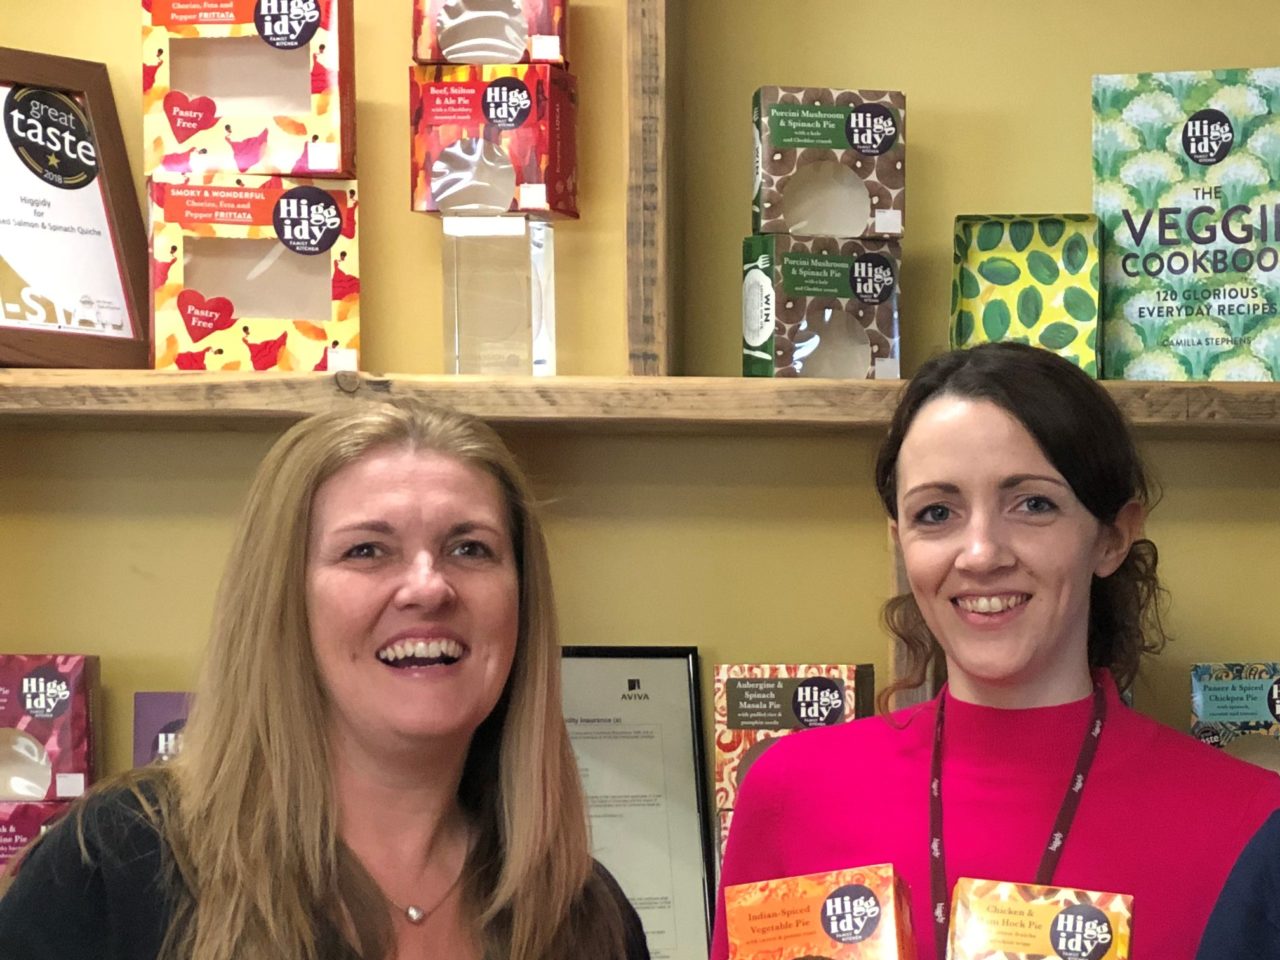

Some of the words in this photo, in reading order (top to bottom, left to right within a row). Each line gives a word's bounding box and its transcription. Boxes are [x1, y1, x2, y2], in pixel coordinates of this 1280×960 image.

[30, 100, 76, 130] great
[172, 107, 204, 121] Pastry
[771, 108, 800, 118] Porcini
[802, 110, 844, 120] Mushroom
[176, 118, 198, 129] Free
[779, 119, 787, 127] &
[788, 120, 820, 130] Spinach
[822, 120, 836, 129] Pie
[850, 113, 896, 136] Higg
[1187, 120, 1232, 142] Higg
[10, 108, 96, 166] taste
[853, 129, 885, 148] idy
[1190, 138, 1222, 156] idy
[42, 169, 63, 184] 2018
[171, 189, 201, 198] SMOKY
[211, 191, 265, 200] WONDERFUL
[1193, 186, 1222, 200] THE
[214, 212, 252, 221] FRITTATA
[280, 199, 340, 229] Higg
[283, 219, 327, 244] idy
[1156, 290, 1178, 302] 120
[1183, 287, 1259, 300] GLORIOUS
[186, 305, 220, 320] Pastry
[763, 294, 771, 322] WIN
[1138, 304, 1213, 319] EVERYDAY
[1217, 302, 1278, 316] RECIPES
[192, 318, 214, 329] Free
[1162, 337, 1202, 348] CAMILLA
[1204, 336, 1252, 346] STEPHENS
[22, 678, 70, 700] Higg
[736, 682, 776, 690] Aubergine
[1230, 684, 1236, 692] &
[1239, 684, 1264, 693] Spiced
[26, 694, 60, 712] idy
[744, 692, 776, 700] Spinach
[798, 686, 842, 708] Higg
[1209, 694, 1244, 702] Chickpea
[1246, 694, 1258, 702] Pie
[800, 702, 832, 721] idy
[14, 835, 28, 843] Pie
[748, 905, 810, 921] Indian-Spiced
[826, 896, 880, 917] Higg
[986, 905, 1025, 917] Chicken
[1026, 909, 1034, 917] &
[750, 921, 792, 935] Vegetable
[794, 919, 810, 928] Pie
[830, 914, 868, 934] idy
[1002, 918, 1025, 929] Hock
[1028, 920, 1043, 930] Pie
[1057, 914, 1112, 944] Higg
[1058, 932, 1098, 957] idy
